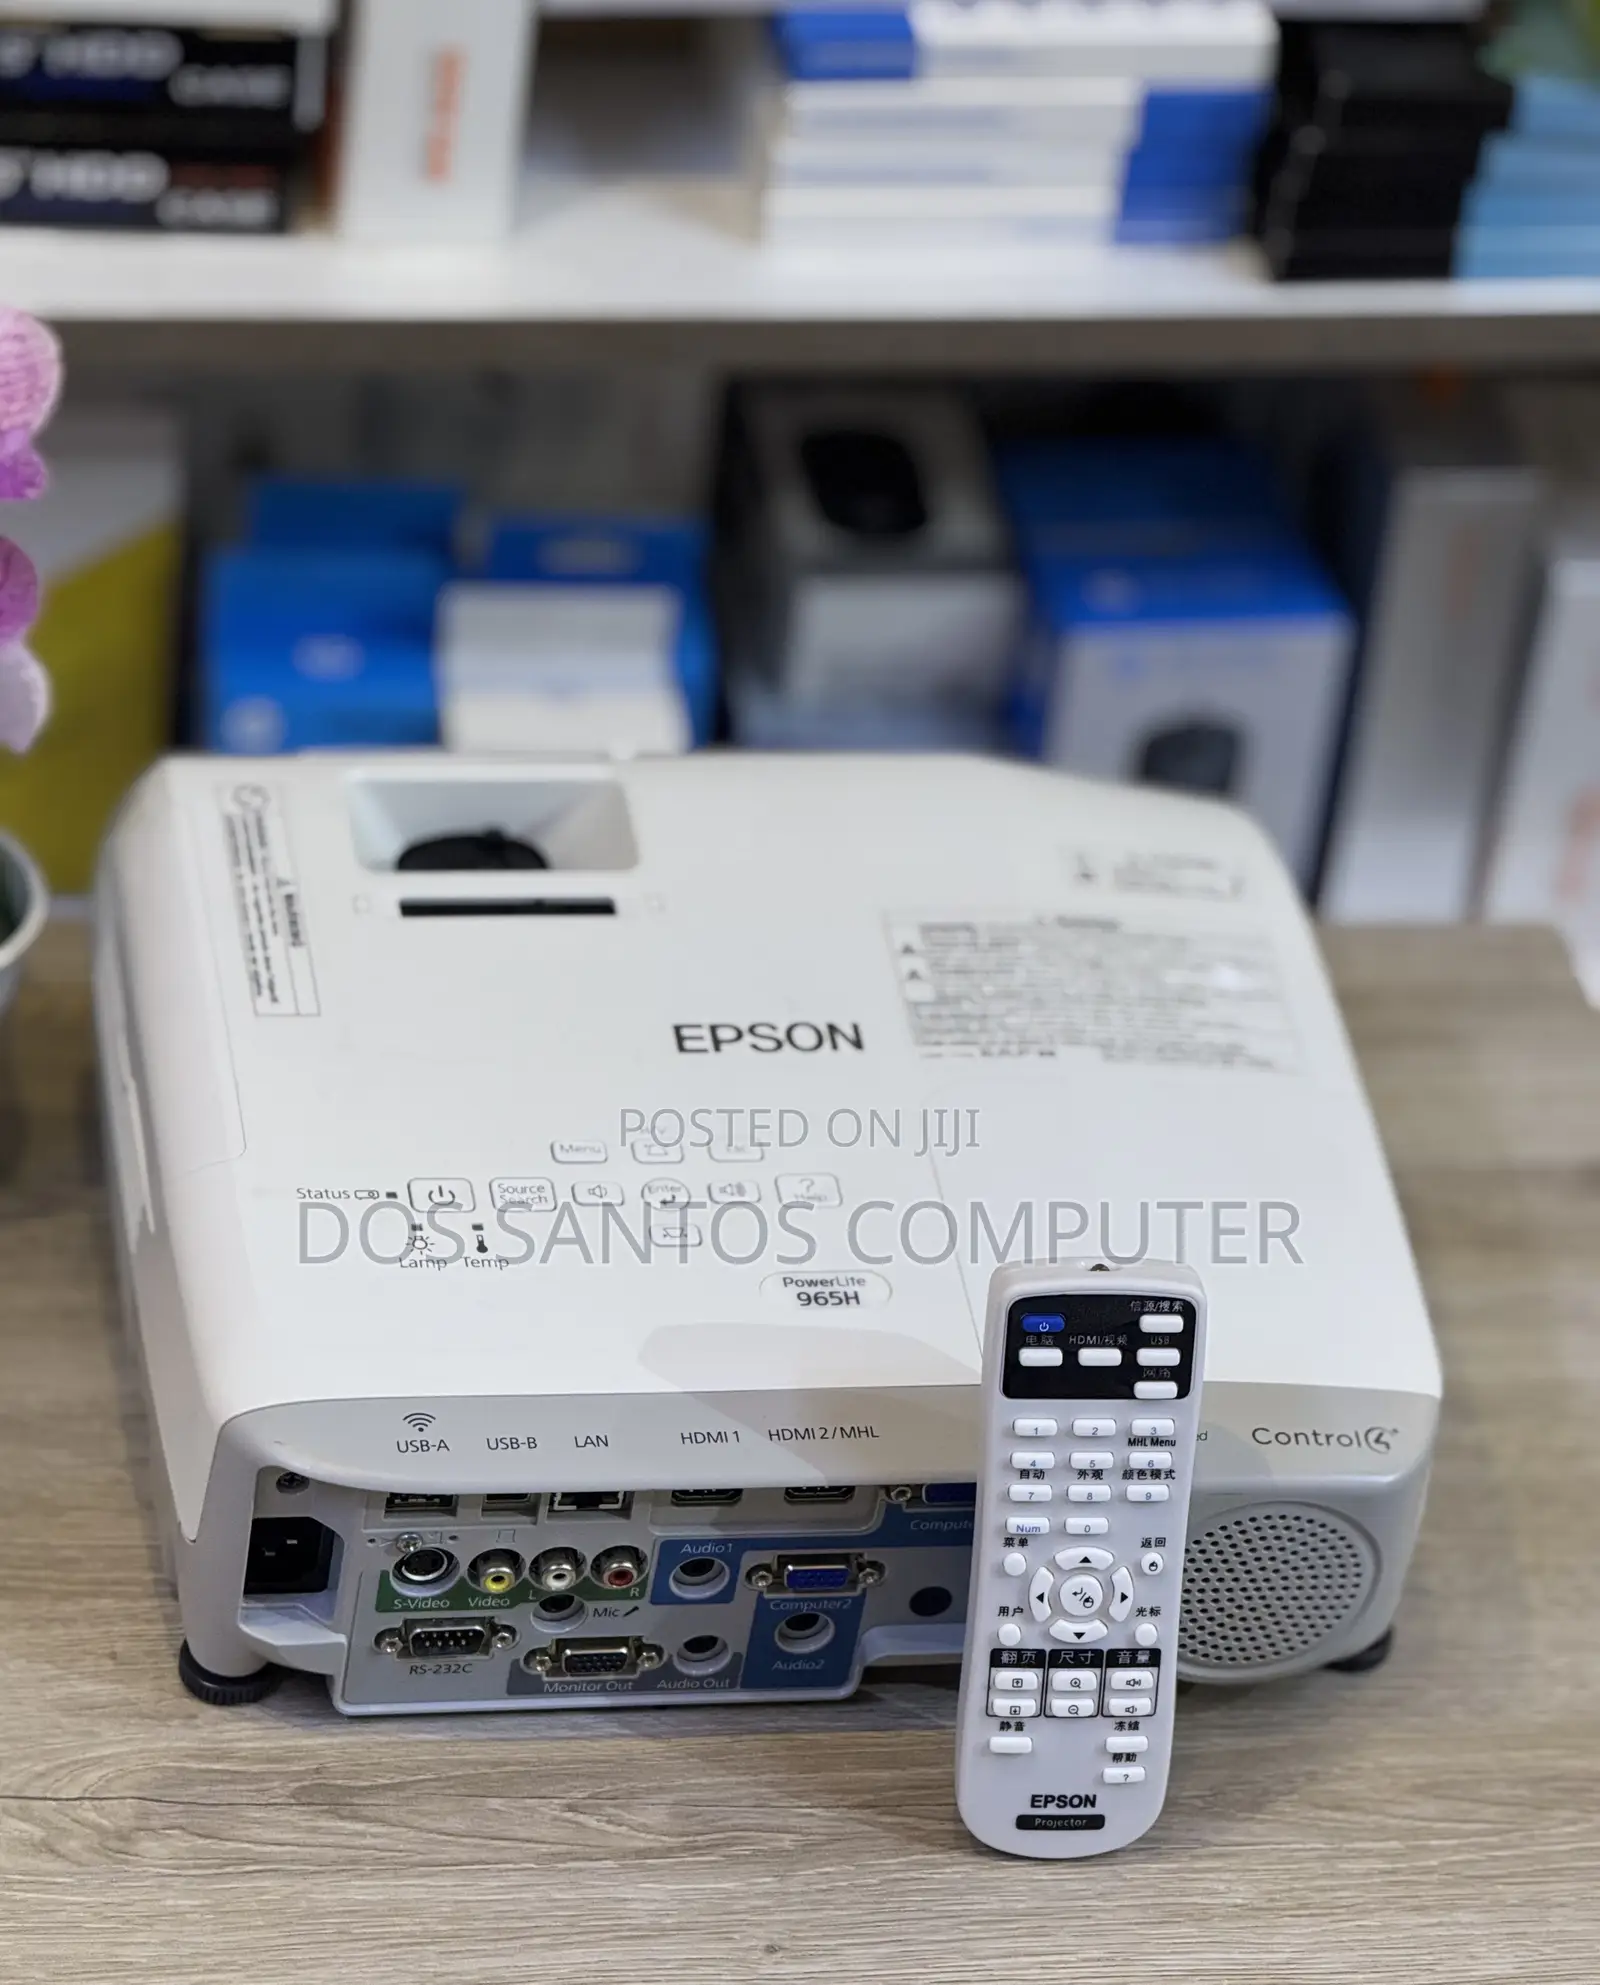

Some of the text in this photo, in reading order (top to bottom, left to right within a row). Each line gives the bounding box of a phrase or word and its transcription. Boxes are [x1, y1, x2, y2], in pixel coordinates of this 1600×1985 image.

[672, 1022, 865, 1053] EPSON
[296, 1187, 350, 1200] Status
[498, 1183, 545, 1195] Source
[499, 1194, 548, 1205] Search
[399, 1256, 448, 1271] Lamp
[463, 1256, 510, 1271] Temp
[782, 1275, 866, 1288] PowerLite
[796, 1290, 861, 1306] 965H
[1150, 1336, 1170, 1345] USB
[1033, 1427, 1039, 1435] 1
[1092, 1427, 1099, 1435] 2
[1150, 1426, 1157, 1435] 3
[396, 1438, 450, 1454] USB-A
[486, 1436, 538, 1450] USB-B
[574, 1434, 609, 1448] LAN
[1127, 1437, 1176, 1448] MHL Menu
[1029, 1459, 1037, 1468] 4
[1089, 1460, 1096, 1468] 5
[1147, 1459, 1155, 1468] 6
[1019, 1469, 1045, 1480] 自动
[1077, 1469, 1104, 1480] 外观
[1121, 1468, 1176, 1480] 颜色模式
[1027, 1492, 1035, 1500] 7
[1086, 1492, 1094, 1500] 8
[1145, 1492, 1152, 1500] 9
[1016, 1523, 1041, 1533] Num
[1003, 1537, 1029, 1548] 菜单
[1140, 1537, 1167, 1548] 返回
[528, 1590, 537, 1600] L
[630, 1587, 640, 1597] R
[393, 1598, 450, 1610] S-Video
[468, 1596, 511, 1608] Video
[592, 1607, 620, 1618] Mic
[997, 1606, 1024, 1617] 用户
[1135, 1606, 1162, 1617] 光标
[1000, 1650, 1037, 1664] 翻页
[1058, 1650, 1095, 1664] 尺寸
[1117, 1650, 1151, 1664] 音量
[409, 1663, 473, 1675] RS-232C
[543, 1681, 634, 1693] Monitor Out
[657, 1677, 730, 1690] Audio Out
[999, 1720, 1026, 1732] 静音
[1030, 1794, 1097, 1808] EPSON
[1034, 1817, 1088, 1828] Projector
